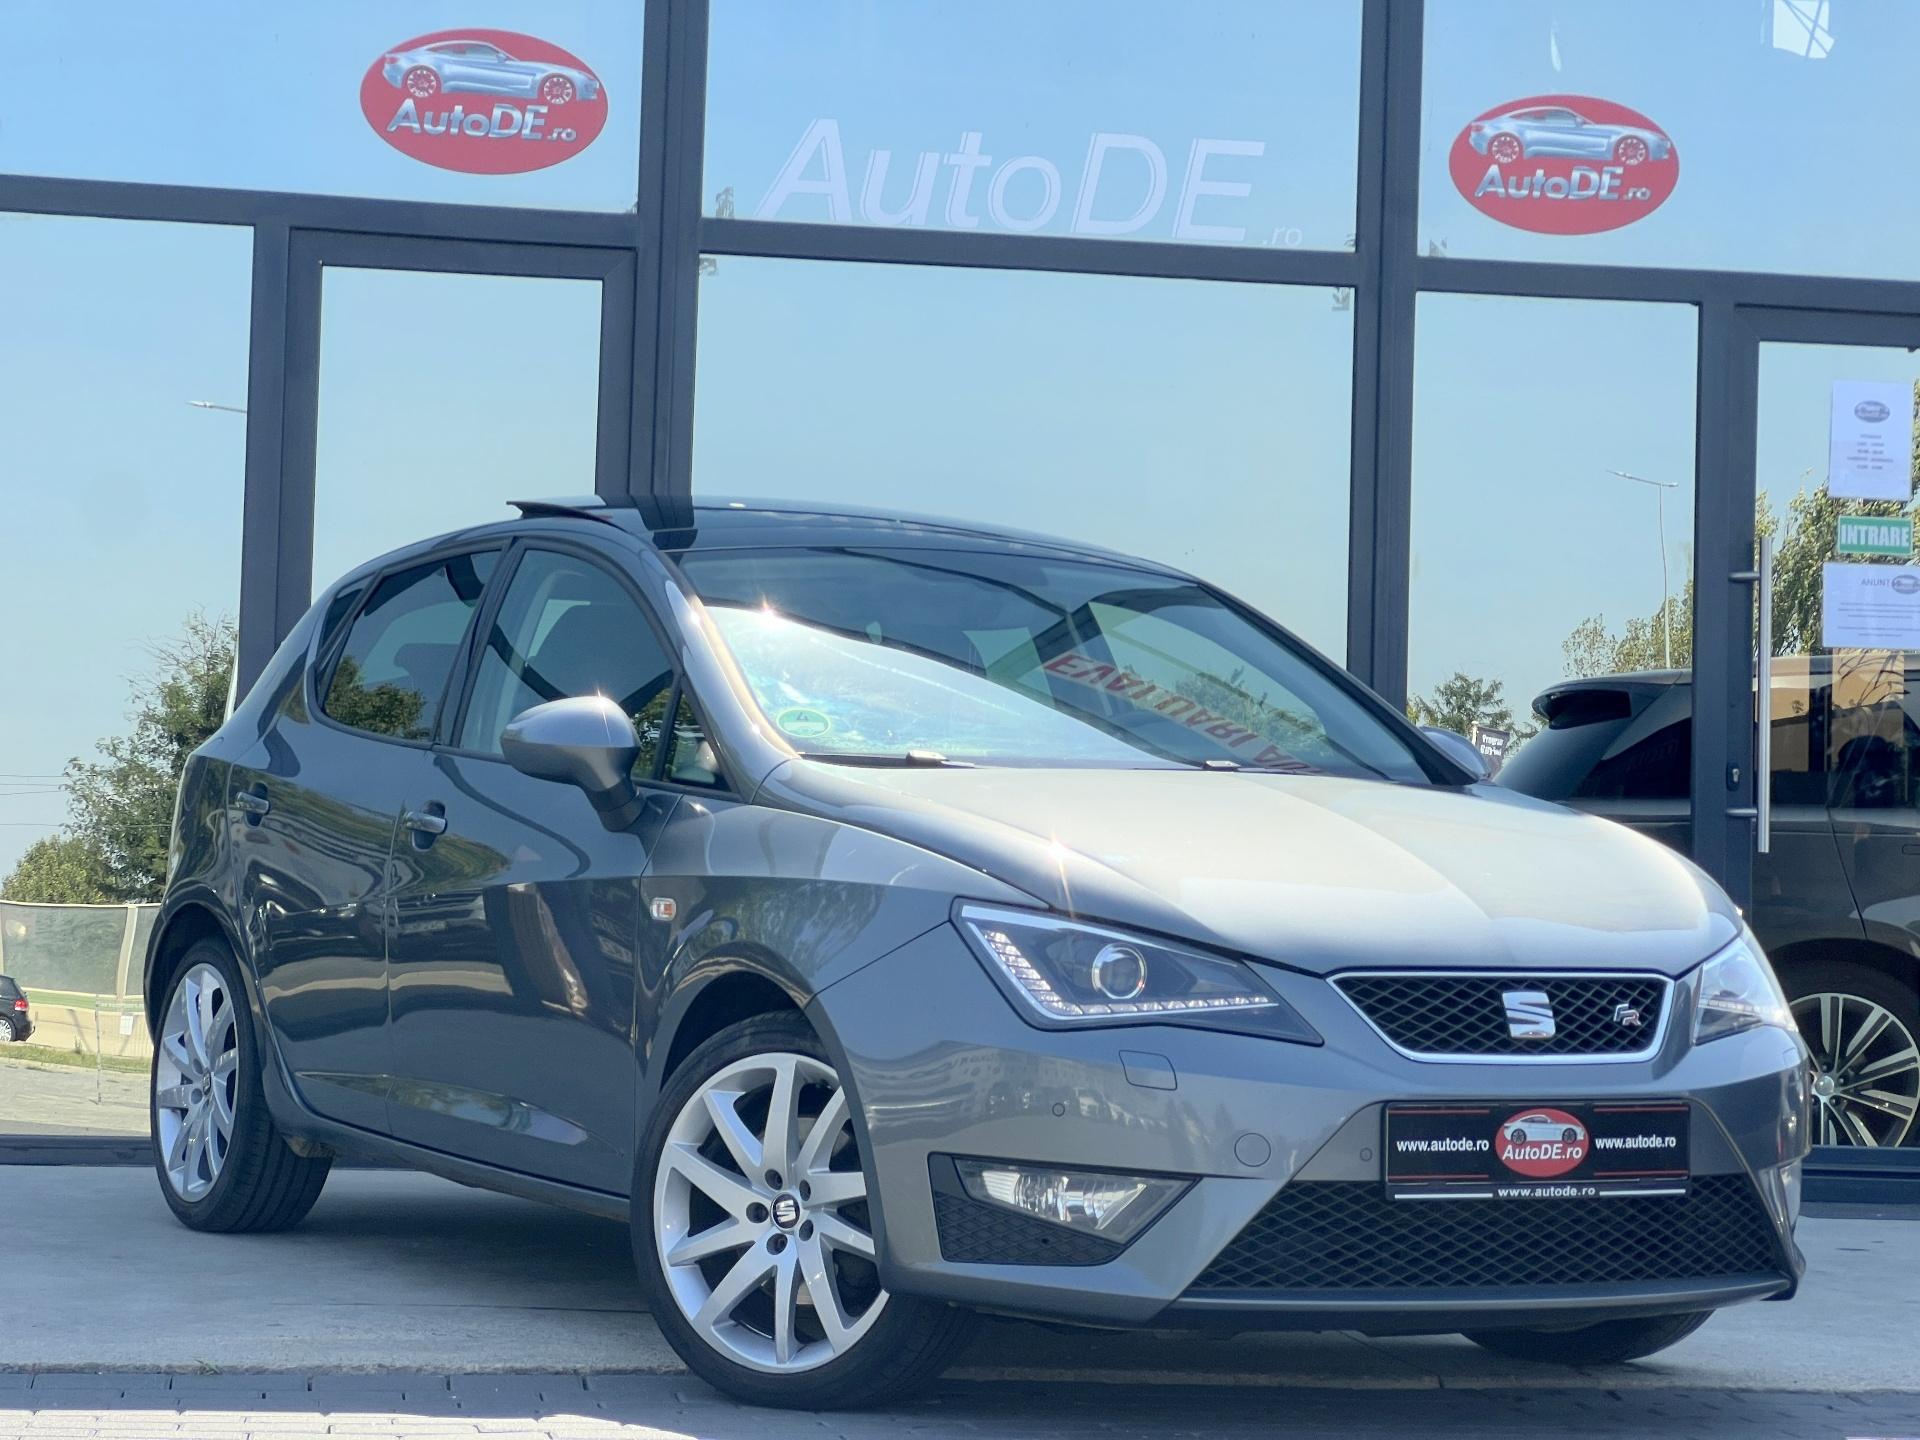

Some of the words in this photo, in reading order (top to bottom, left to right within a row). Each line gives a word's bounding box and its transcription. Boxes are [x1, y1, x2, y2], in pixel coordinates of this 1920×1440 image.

[1840, 523, 1910, 547] INTRARE
[1396, 1137, 1490, 1153] www.autode.ro
[1595, 1135, 1677, 1150] www.autode.ro
[1502, 1143, 1583, 1161] AutoDE.ro
[1497, 1186, 1596, 1199] www.autode.ro
